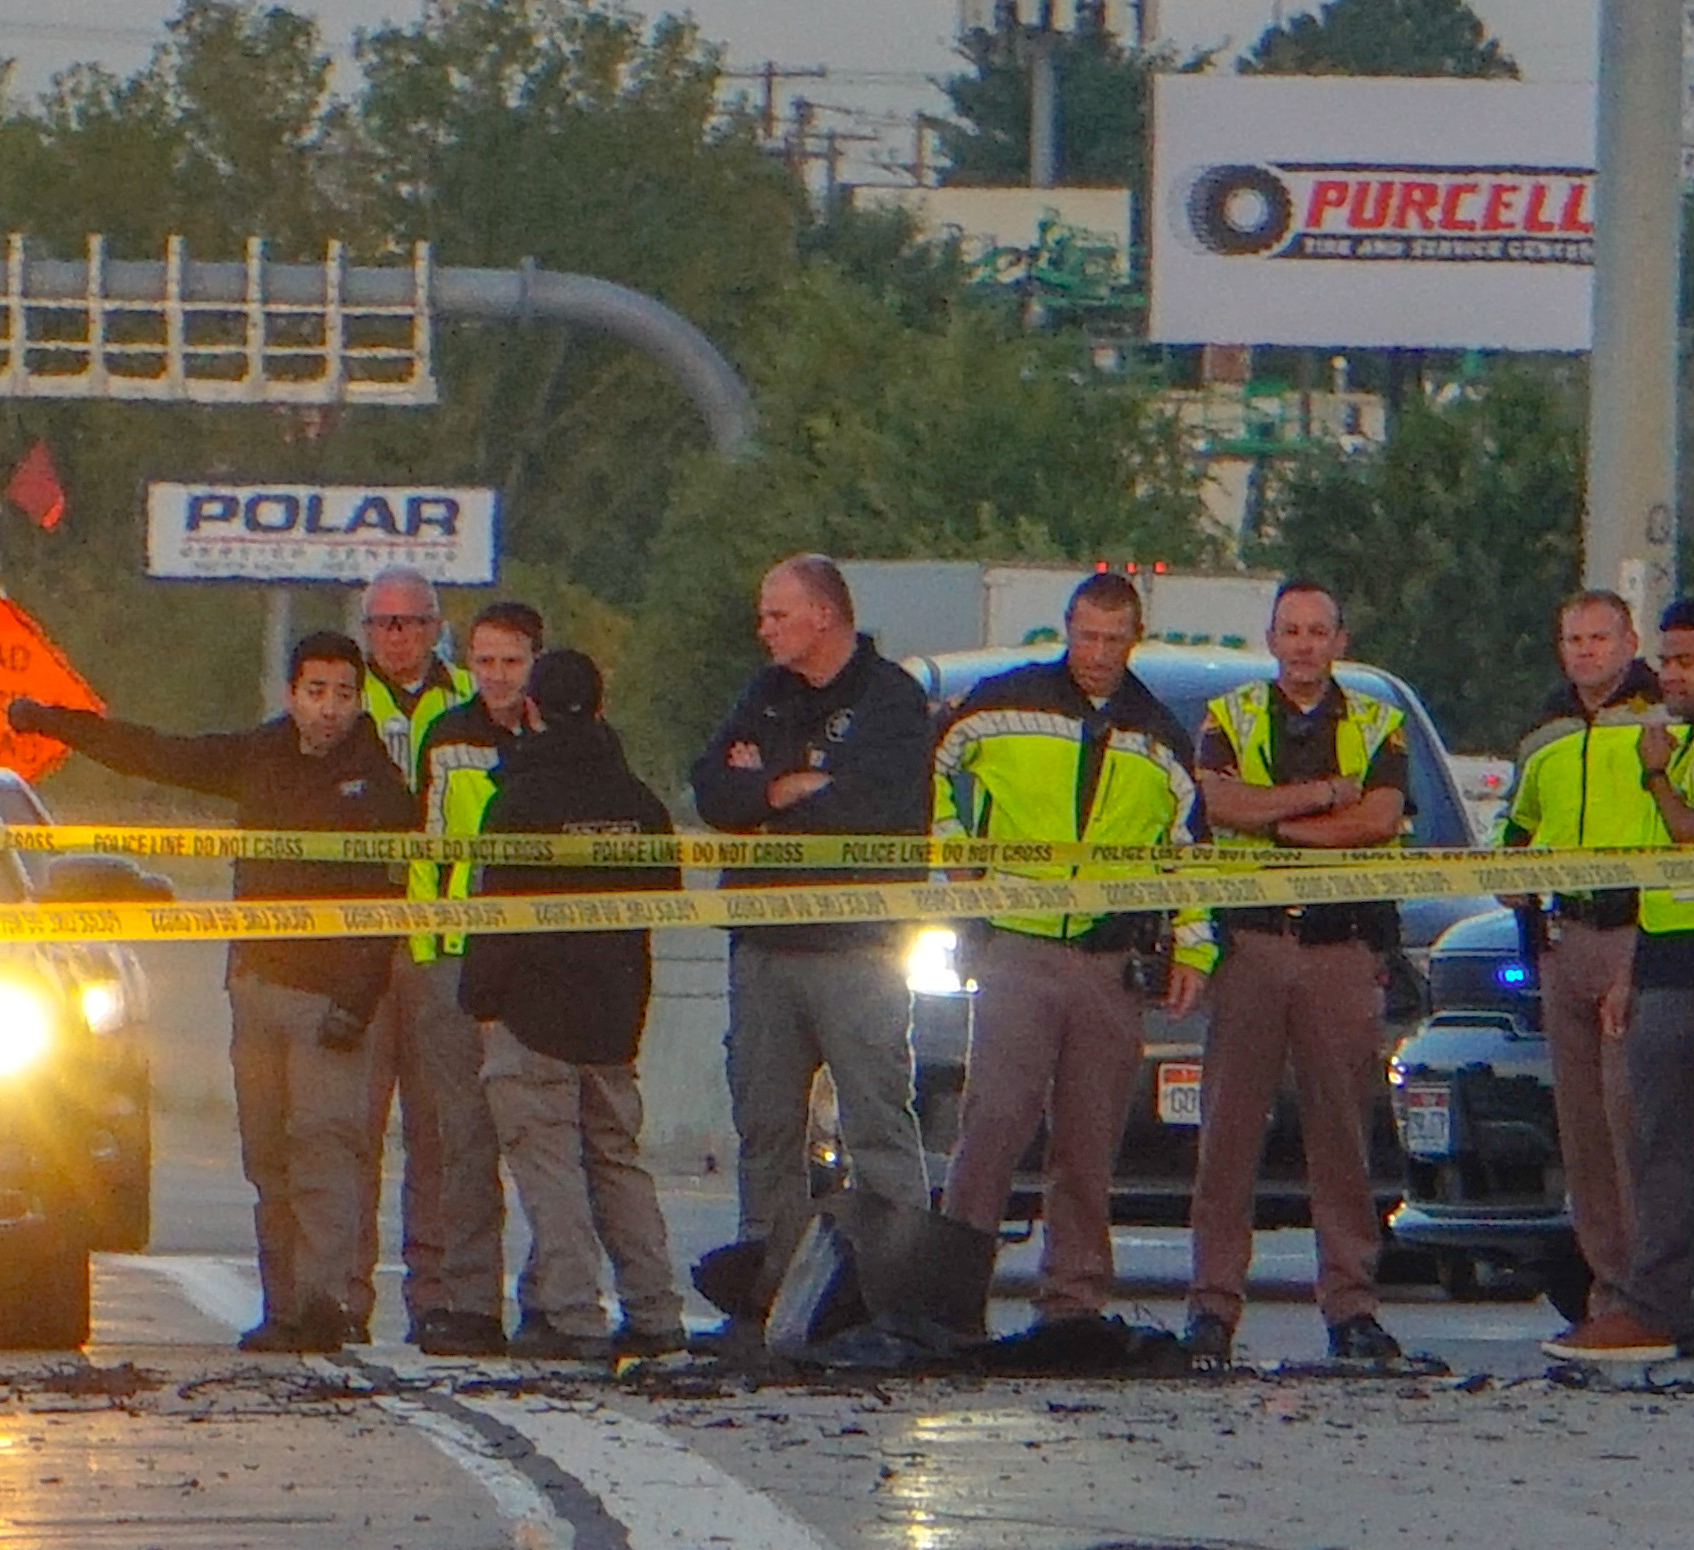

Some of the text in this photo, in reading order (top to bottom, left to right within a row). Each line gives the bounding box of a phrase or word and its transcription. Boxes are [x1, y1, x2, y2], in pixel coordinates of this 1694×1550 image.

[1306, 179, 1595, 233] PURCELL
[185, 493, 460, 536] POLAR
[93, 833, 304, 857] POLICE LINE DO NOT CROSS
[343, 839, 395, 859] POLICE
[402, 839, 434, 860] LINE
[442, 840, 464, 860] DO
[469, 840, 497, 860] NOT
[592, 841, 804, 863] POLICE LINE DO NOT CROSS
[842, 842, 1052, 863] POLICE LINE DO NOT CROSS
